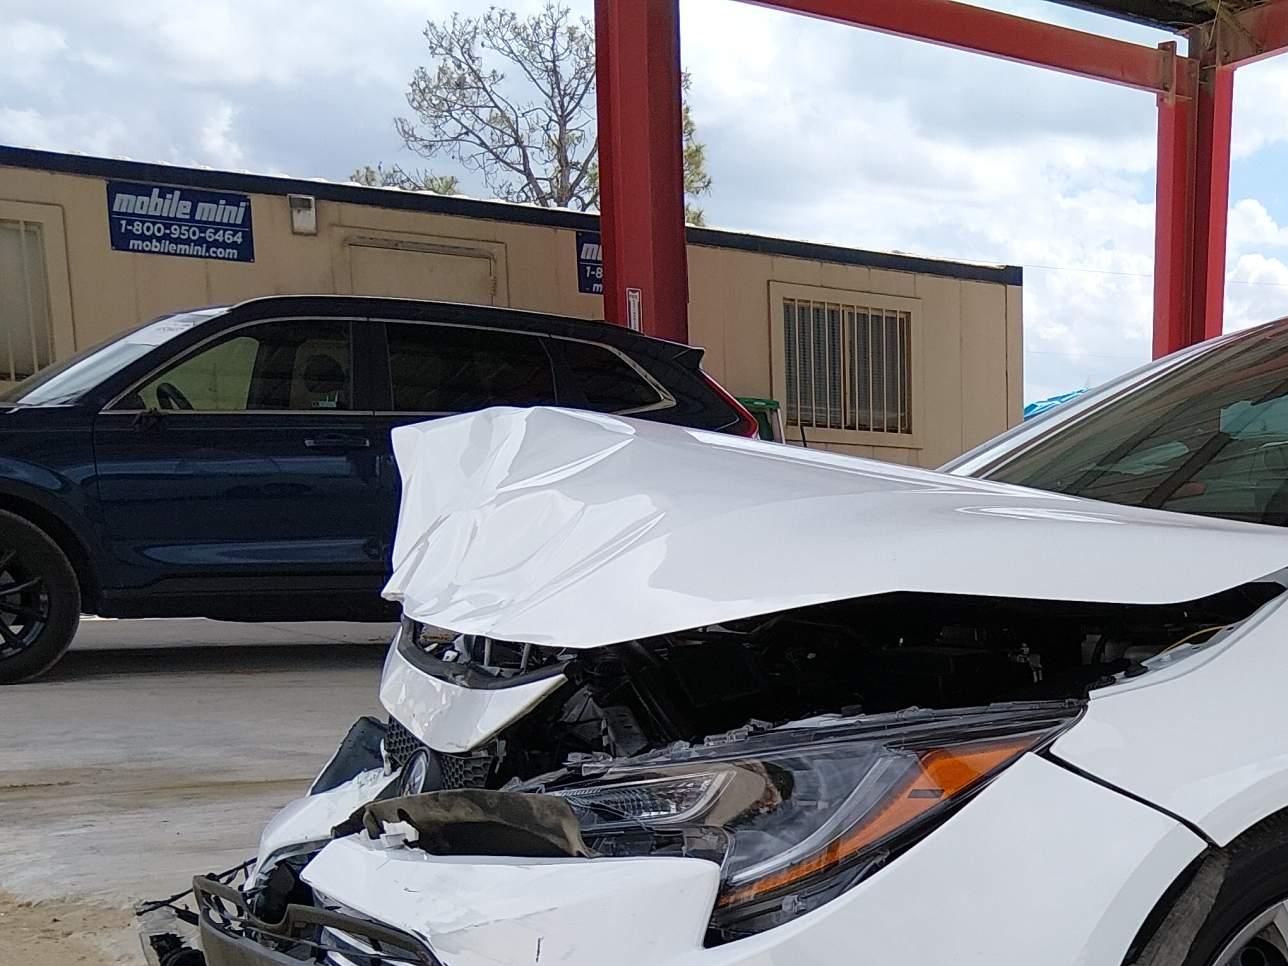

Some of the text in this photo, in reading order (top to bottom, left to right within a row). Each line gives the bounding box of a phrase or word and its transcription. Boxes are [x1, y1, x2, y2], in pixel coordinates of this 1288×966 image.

[112, 188, 246, 224] mobile mini
[119, 220, 243, 244] 1-800-950-6464
[129, 239, 238, 259] mobilemini.com
